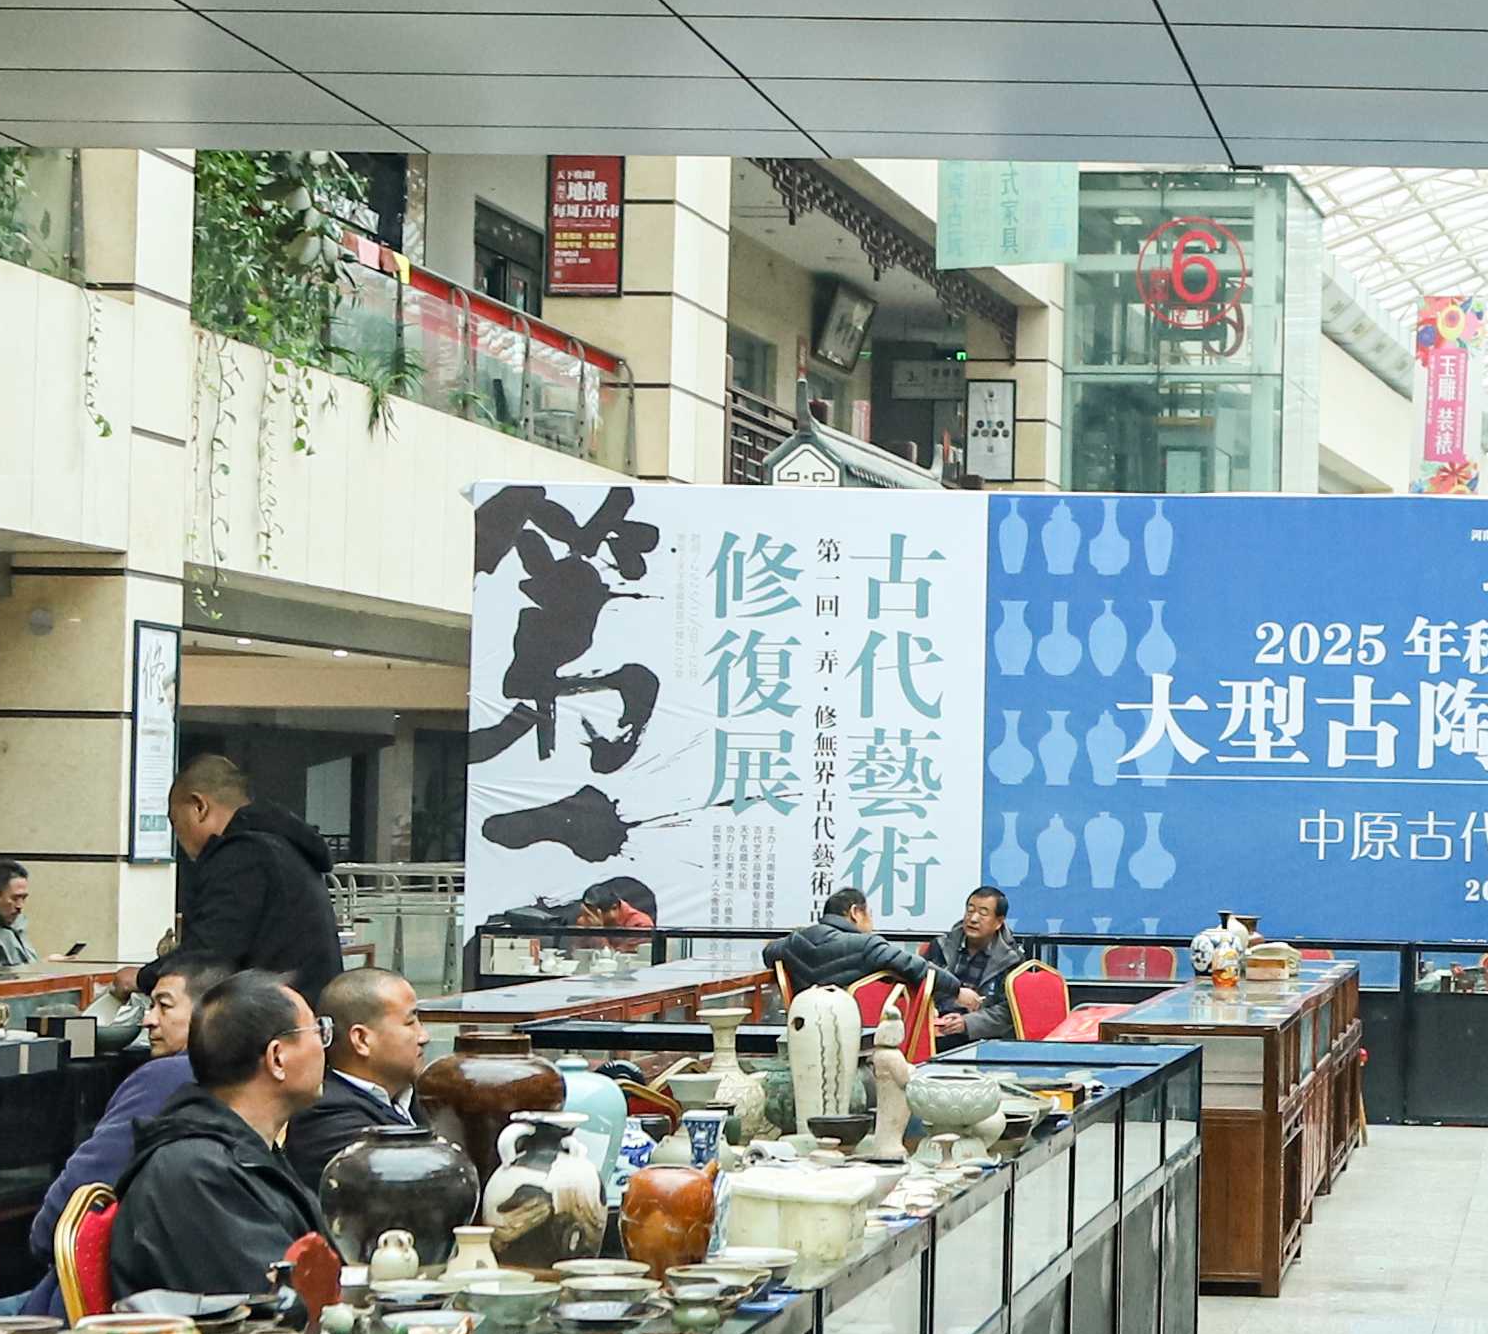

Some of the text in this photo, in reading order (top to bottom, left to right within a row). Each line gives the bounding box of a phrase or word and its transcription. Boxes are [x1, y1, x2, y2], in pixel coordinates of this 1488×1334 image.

[1171, 229, 1218, 304] 6
[700, 531, 805, 817] 修復展
[841, 533, 947, 917] 古代藝術
[1255, 622, 1386, 665] 2025
